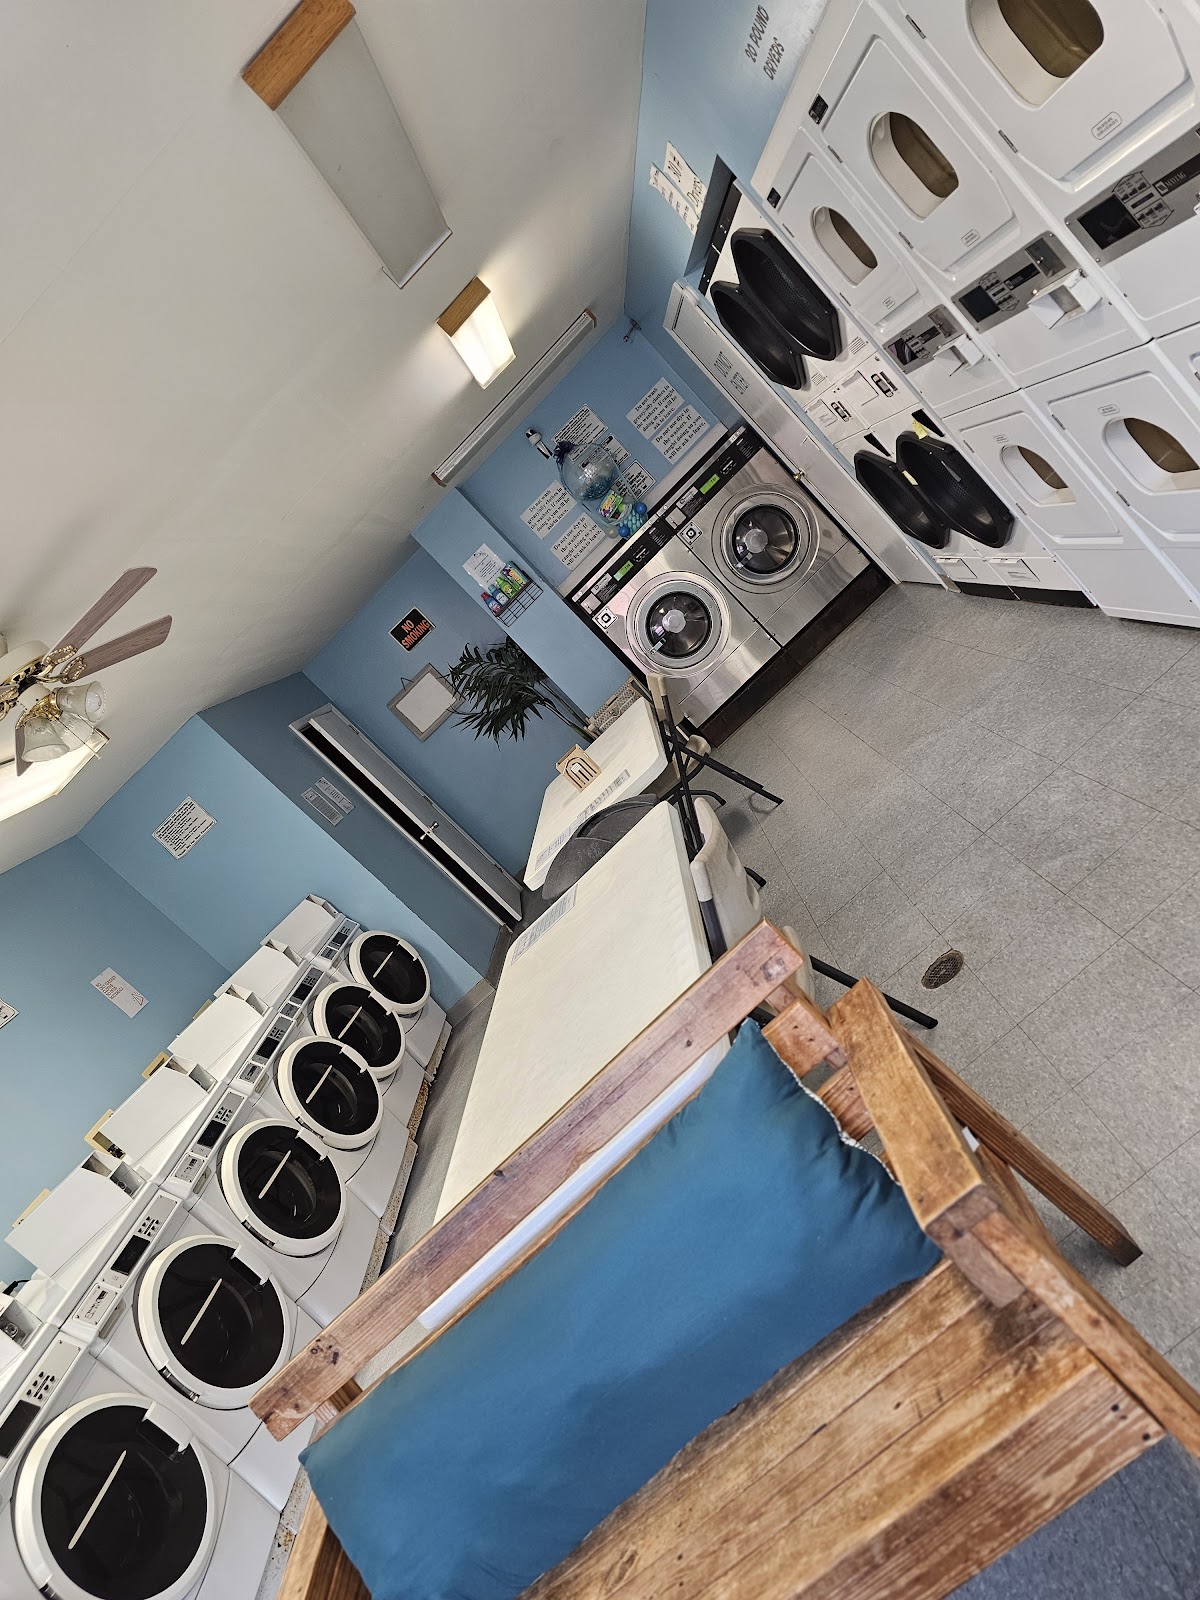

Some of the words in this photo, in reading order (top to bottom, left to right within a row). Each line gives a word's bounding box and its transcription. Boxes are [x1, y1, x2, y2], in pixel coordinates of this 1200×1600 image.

[748, 4, 769, 49] POUND
[744, 42, 757, 63] 20
[762, 36, 784, 80] DRYERS
[1163, 170, 1187, 188] MAYTAG
[654, 433, 664, 443] Do
[661, 426, 670, 437] not
[668, 419, 678, 429] use
[674, 411, 686, 422] dye
[661, 435, 671, 446] the
[662, 439, 678, 456] caught
[674, 426, 690, 442] doing
[691, 414, 702, 425] you
[399, 618, 431, 649] SMOKING
[400, 618, 415, 634] NO
